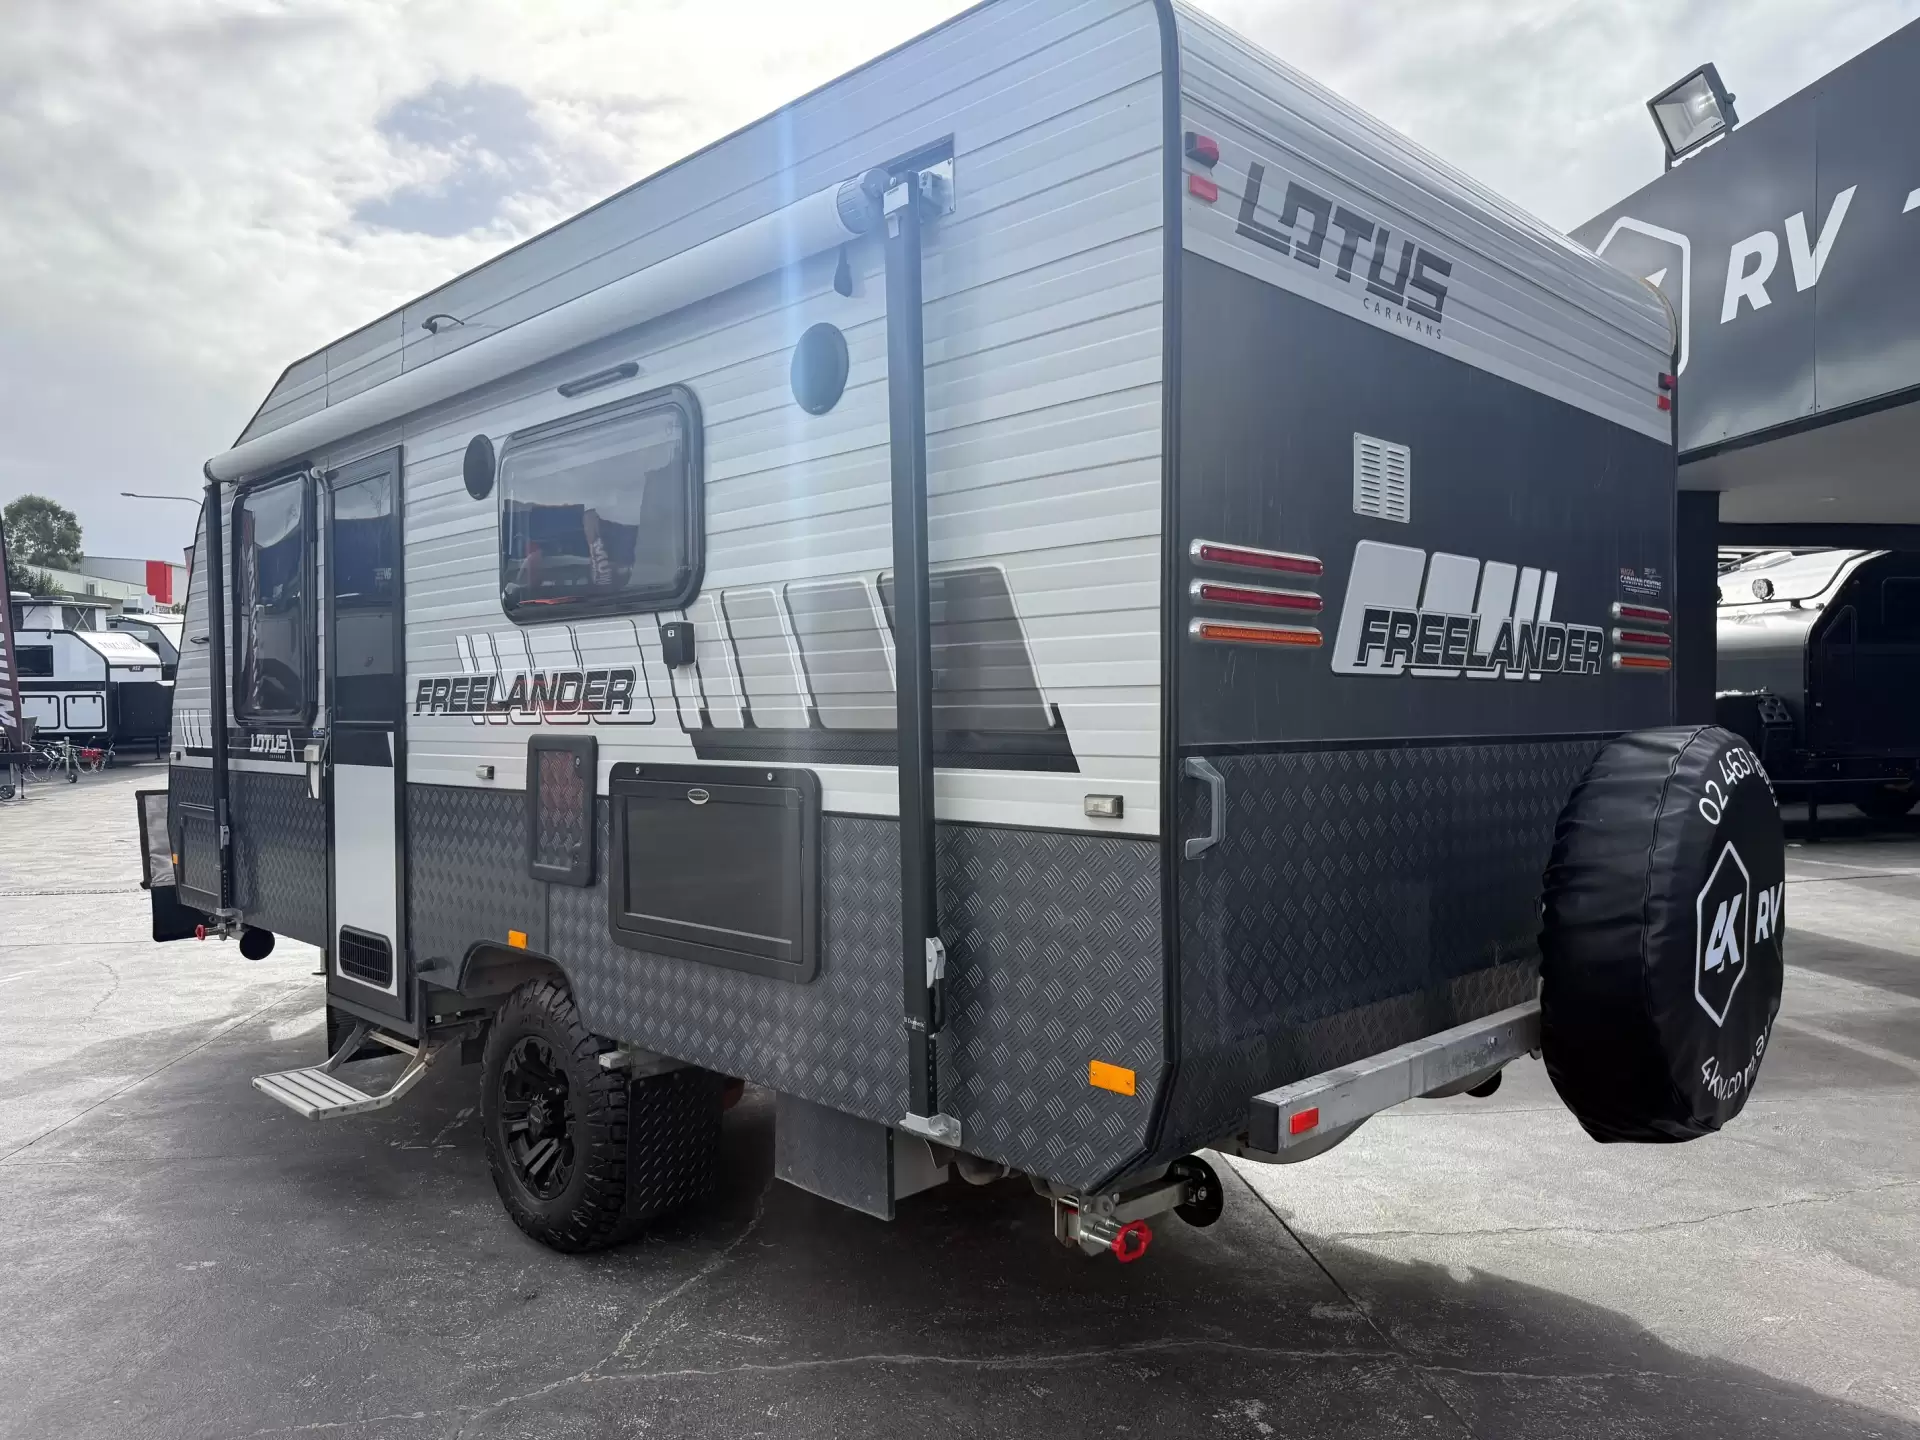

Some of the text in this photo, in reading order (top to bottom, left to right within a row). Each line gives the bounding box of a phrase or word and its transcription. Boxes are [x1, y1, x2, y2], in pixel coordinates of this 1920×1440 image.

[1235, 161, 1453, 323] LOTUS
[1720, 184, 1858, 324] RV
[1363, 297, 1442, 340] CARAVANS
[1353, 605, 1604, 675] FREELANDER
[413, 665, 637, 716] FREELANDER
[250, 734, 288, 754] LOTUS
[1699, 779, 1729, 825] 02
[1718, 747, 1755, 786] 4631
[1755, 881, 1784, 944] RV
